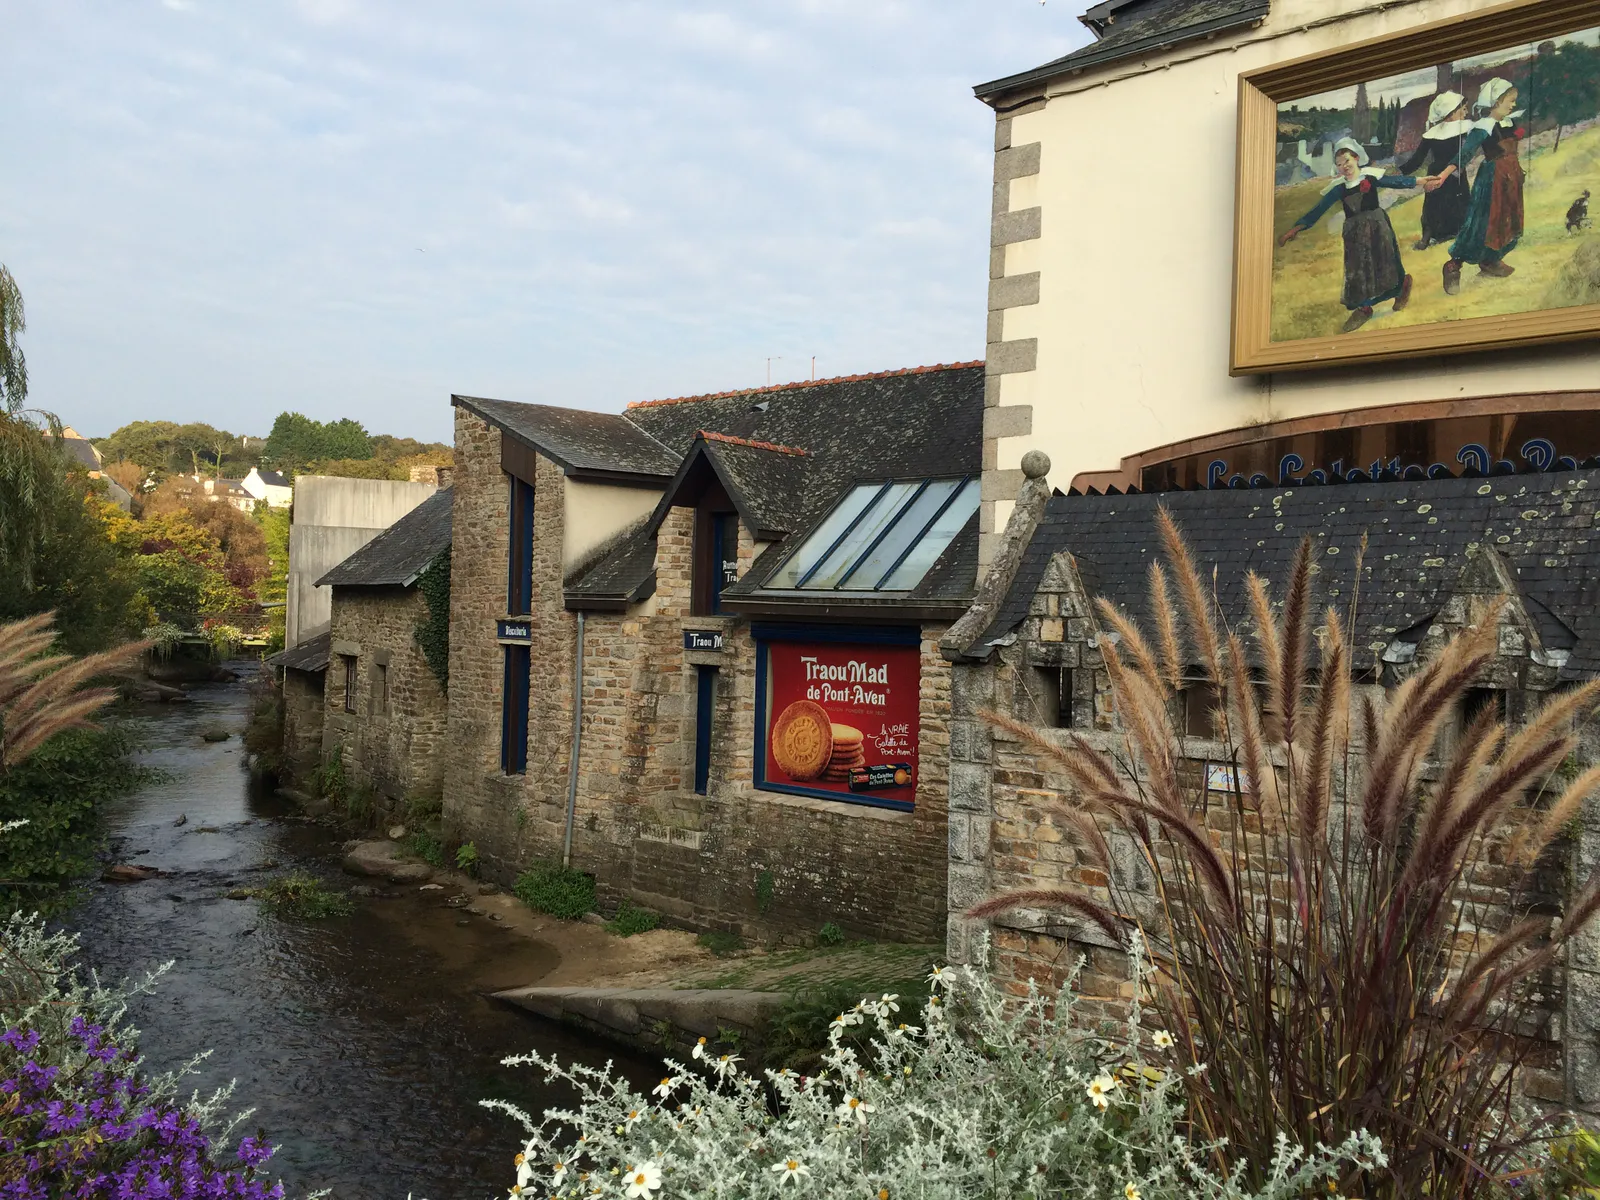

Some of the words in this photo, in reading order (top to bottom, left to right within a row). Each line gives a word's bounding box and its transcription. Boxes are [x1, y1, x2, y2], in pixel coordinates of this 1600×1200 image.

[690, 633, 712, 648] Traou
[800, 656, 847, 681] Traou
[847, 660, 888, 684] Mad
[807, 685, 820, 700] de
[888, 724, 909, 735] VRAIE
[874, 734, 899, 749] Galette
